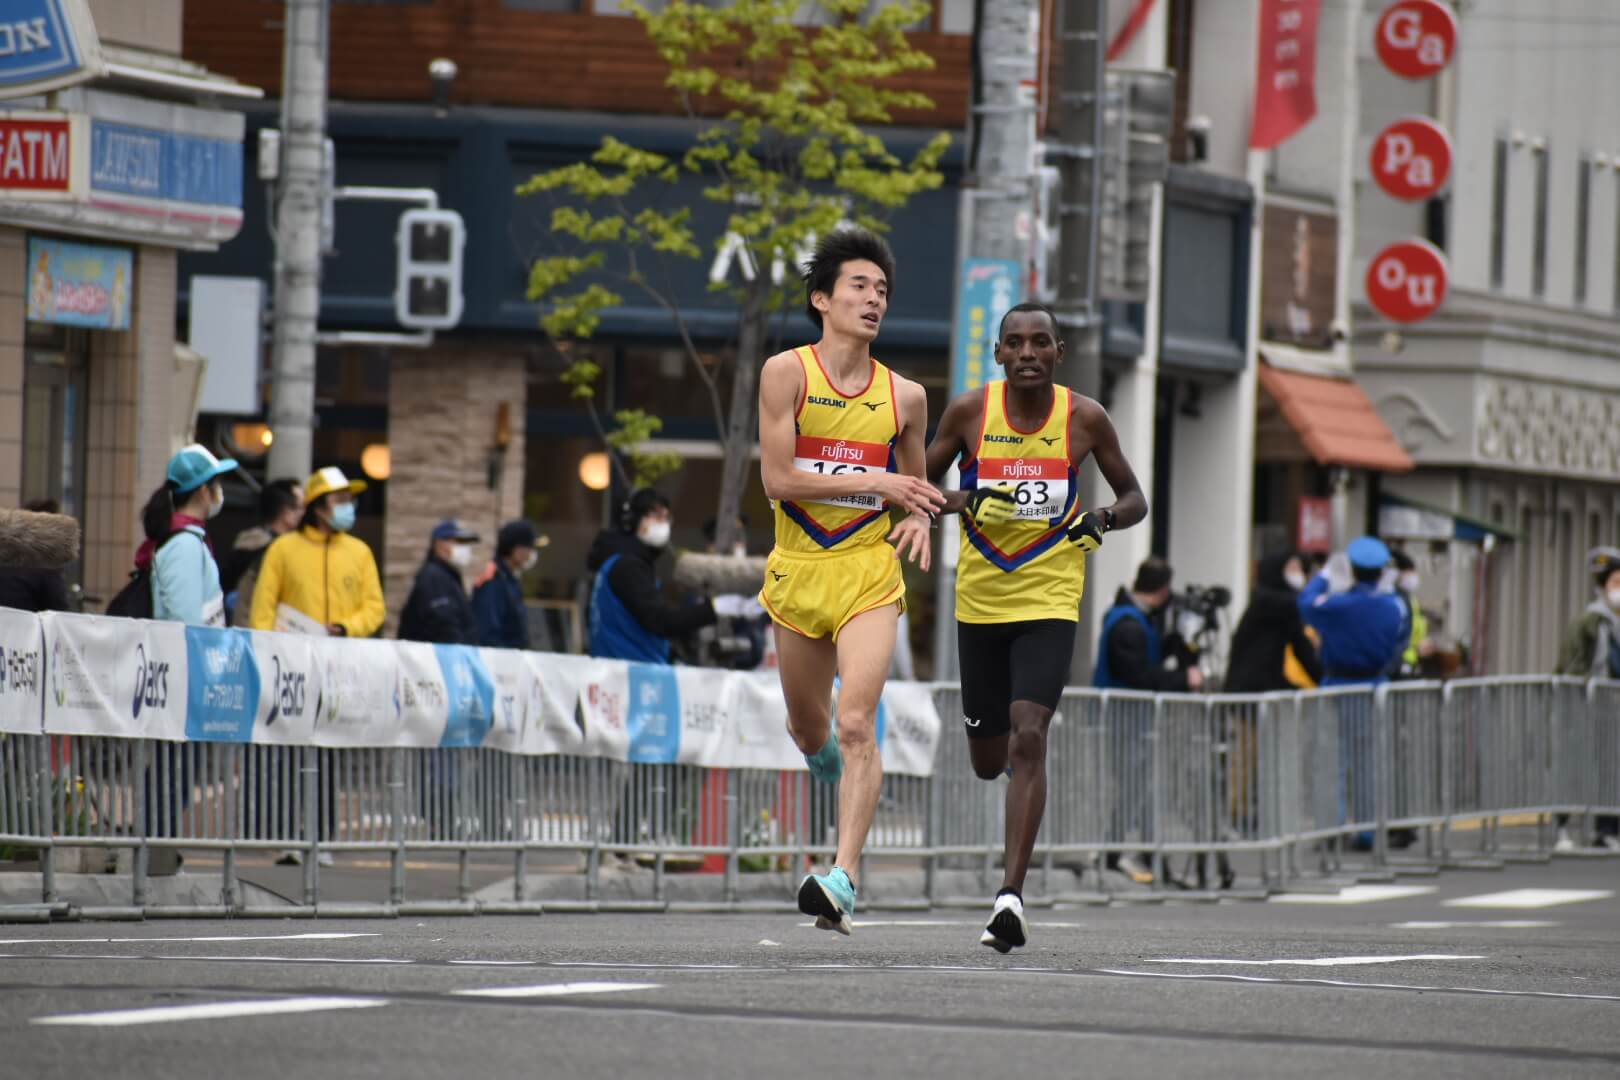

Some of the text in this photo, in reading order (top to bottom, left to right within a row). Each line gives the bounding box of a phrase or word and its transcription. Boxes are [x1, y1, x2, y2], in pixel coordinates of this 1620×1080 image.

[1384, 9, 1445, 66] Ga
[807, 395, 847, 409] SUZUKI
[983, 434, 1024, 444] SUZUKI
[821, 441, 864, 461] FUJITSU
[1003, 459, 1042, 479] FUJITSU
[997, 481, 1049, 506] 63
[1015, 504, 1059, 517] 大日本印刷
